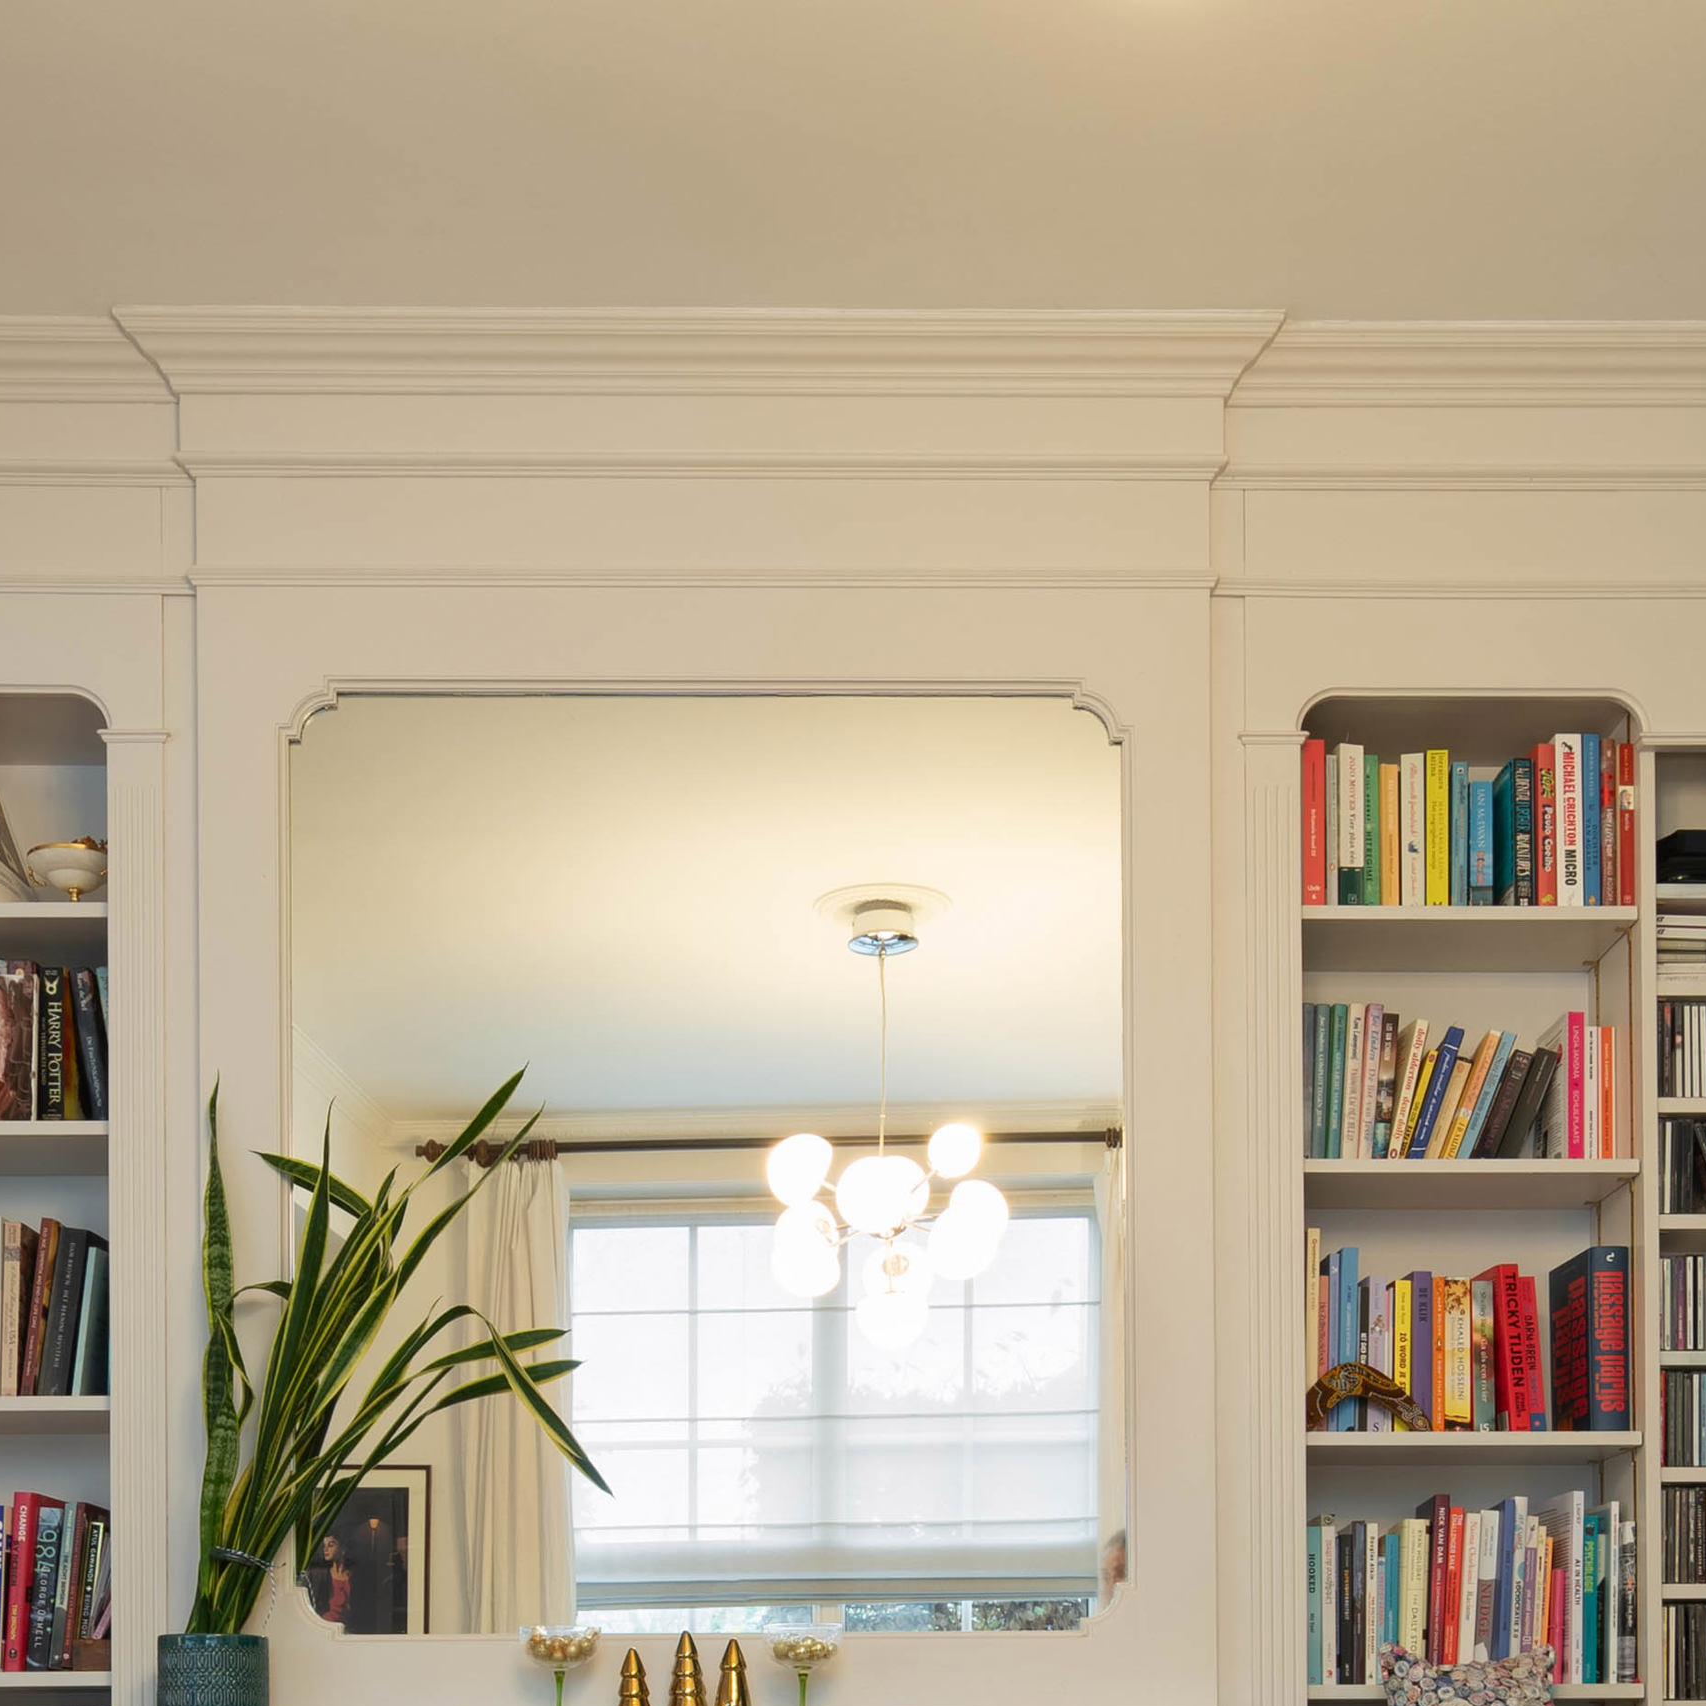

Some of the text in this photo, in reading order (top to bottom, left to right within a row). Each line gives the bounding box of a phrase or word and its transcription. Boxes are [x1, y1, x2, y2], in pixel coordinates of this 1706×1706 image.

[1544, 807, 1553, 872] Paulo Coelho
[1563, 752, 1577, 886] MICHAEL CRICHTON MICRO
[47, 1001, 62, 1104] HARRY POTTER
[1393, 1028, 1425, 1141] dolly alderton dear dolly
[1419, 1287, 1428, 1322] DE KLIK
[1505, 1272, 1525, 1386] TRICKY TIJDEN
[1594, 1271, 1625, 1412] passage parijs
[1400, 1371, 1406, 1379] JE
[1457, 1317, 1465, 1400] KHALED HOSSEINI
[1524, 1315, 1536, 1370] DARM BREIN
[1567, 1275, 1589, 1420] passage
[18, 1505, 28, 1542] CHANGE
[34, 1519, 59, 1648] 1984 GEORGE ORWELL
[1575, 1559, 1581, 1568] AI
[1584, 1540, 1593, 1592] PSYCHOLOGIE
[1478, 1584, 1492, 1636] NUDGE
